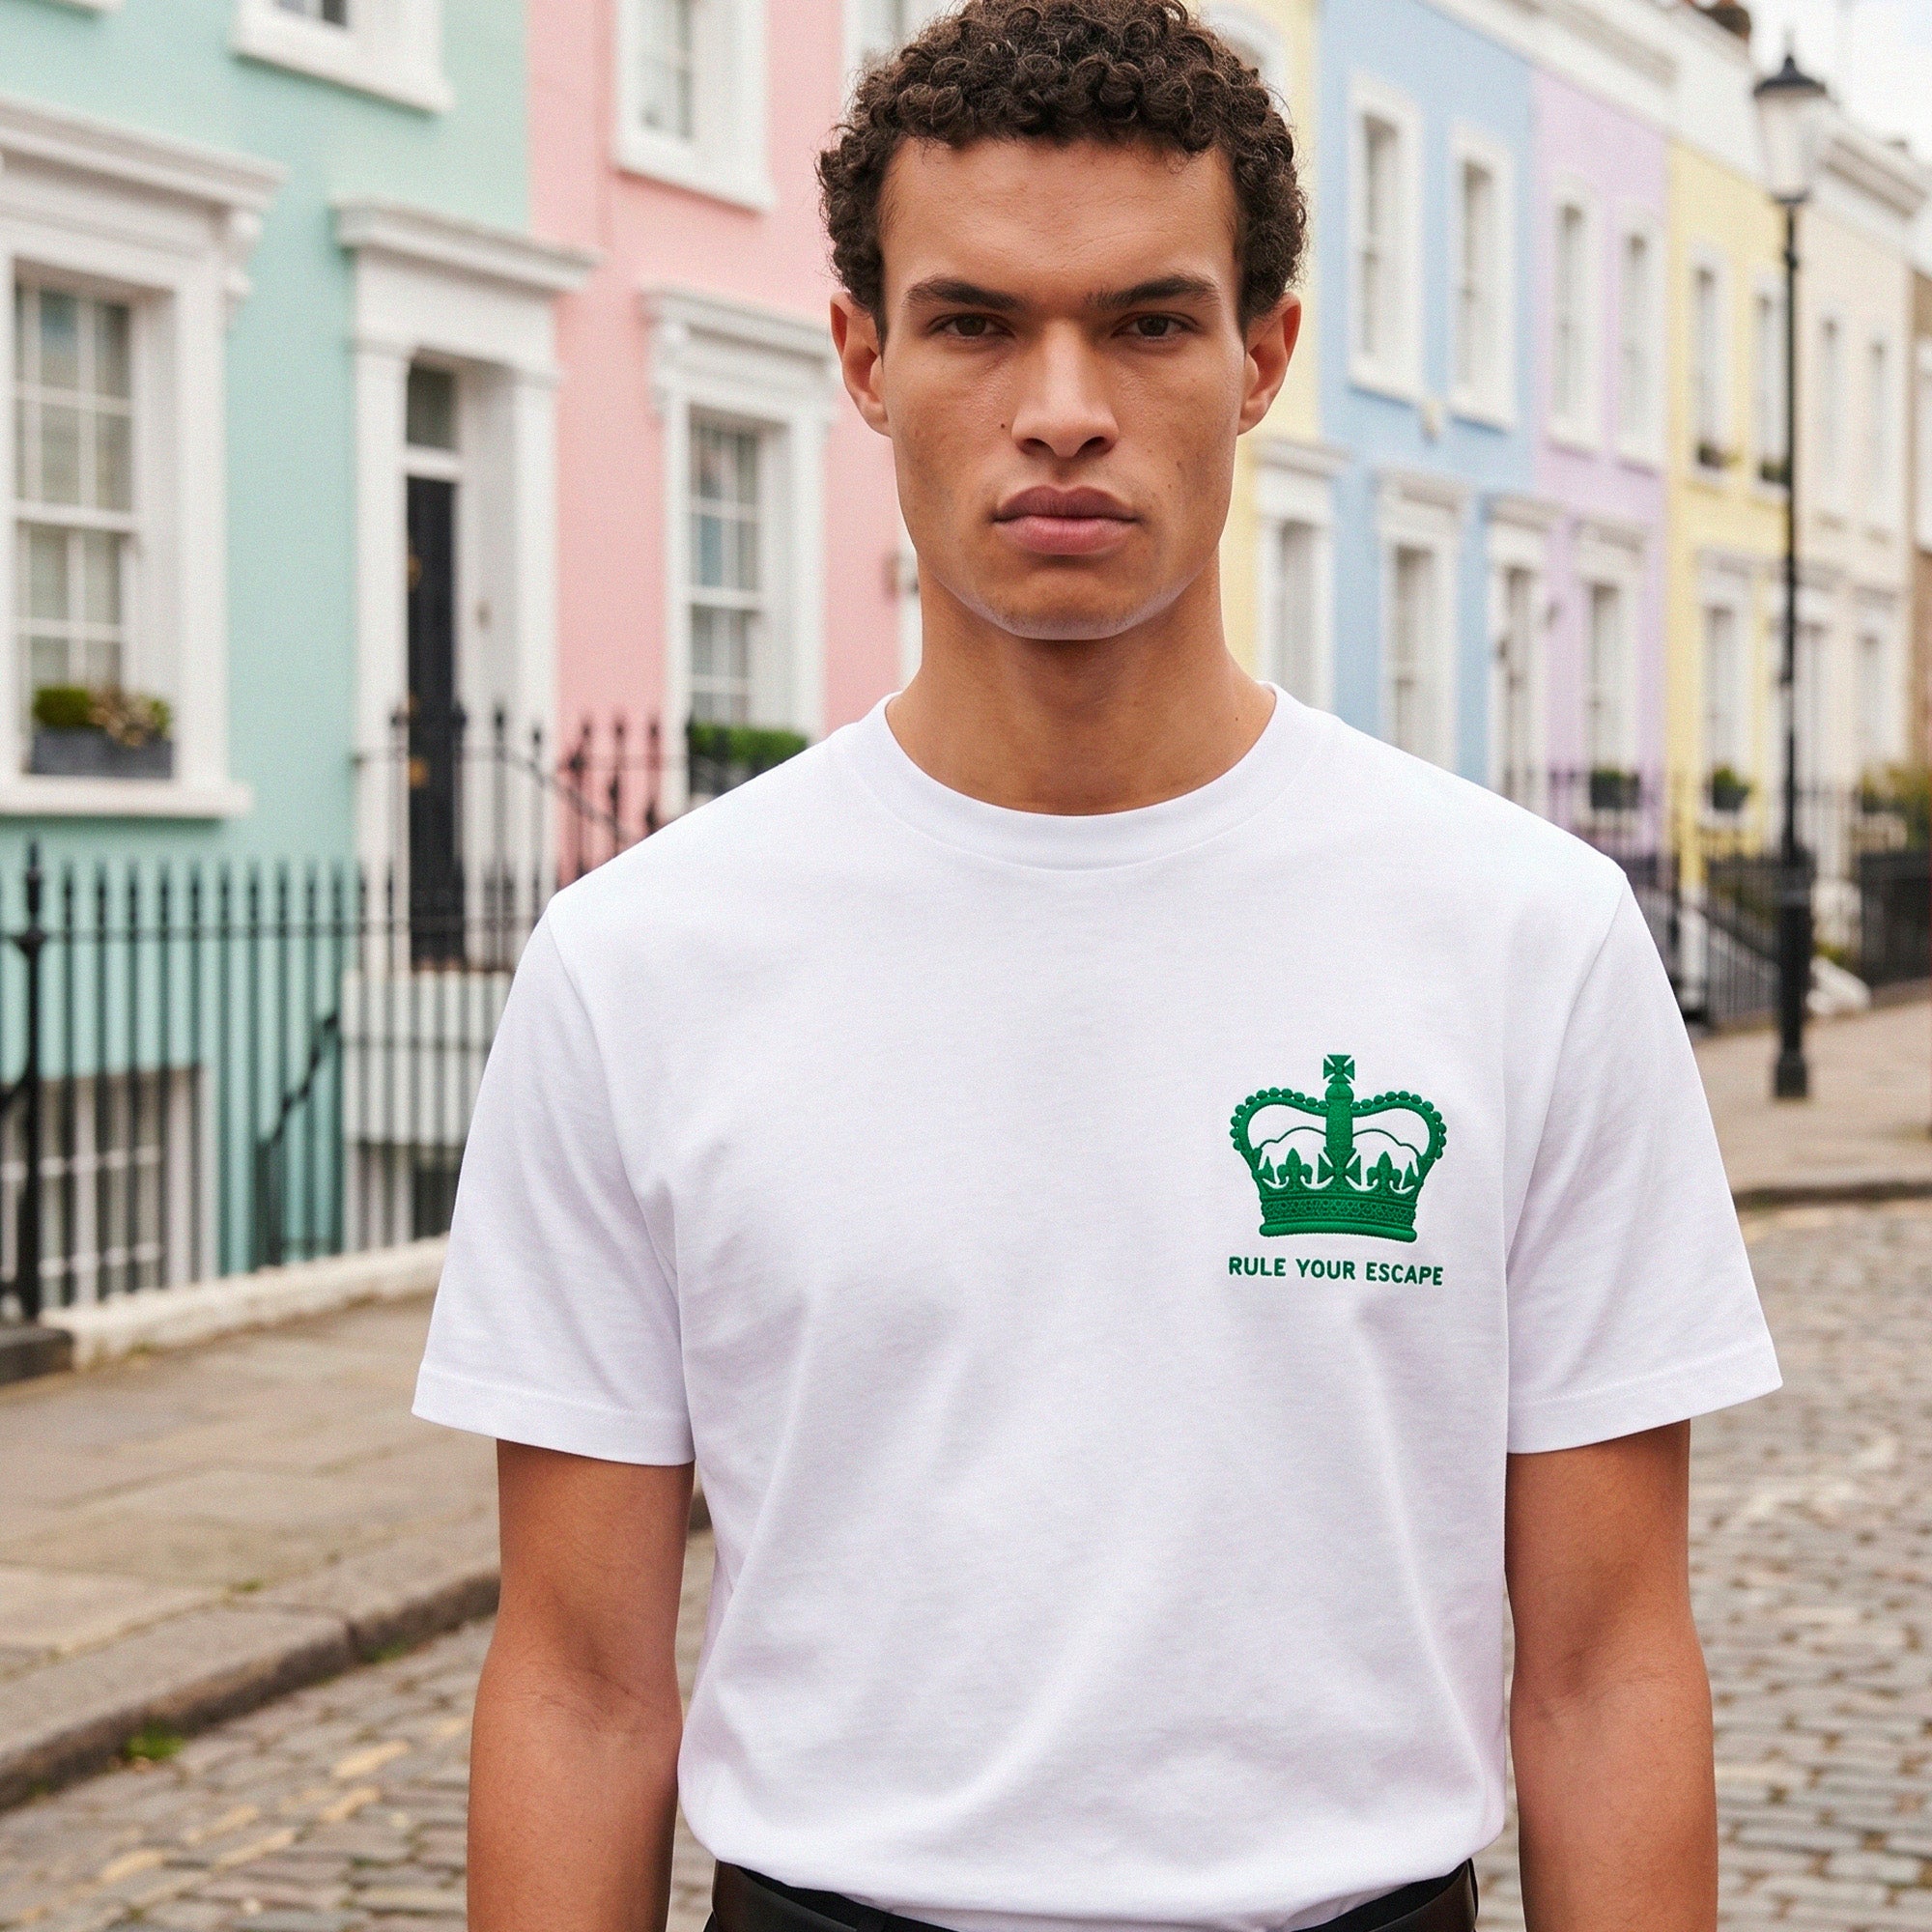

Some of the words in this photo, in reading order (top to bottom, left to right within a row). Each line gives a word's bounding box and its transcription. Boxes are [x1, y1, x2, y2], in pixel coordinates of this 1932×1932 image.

[1228, 1256, 1287, 1277] RULE
[1295, 1259, 1355, 1280] YOUR
[1365, 1262, 1444, 1286] ESCAPE
